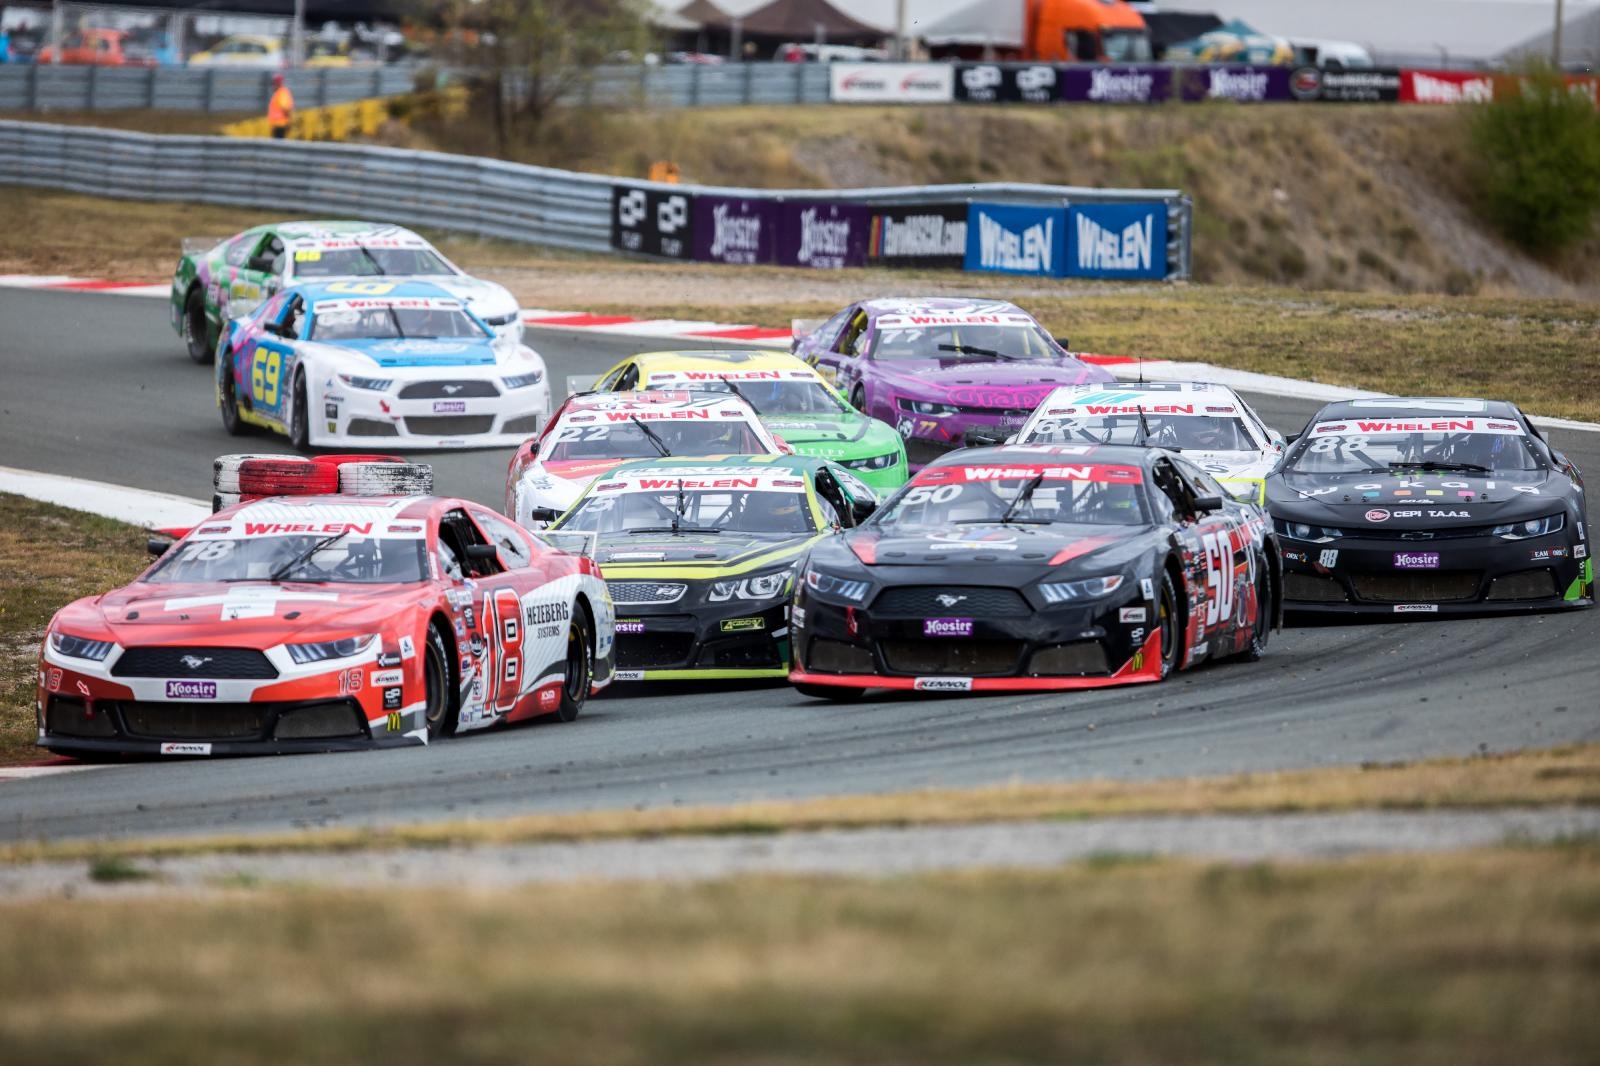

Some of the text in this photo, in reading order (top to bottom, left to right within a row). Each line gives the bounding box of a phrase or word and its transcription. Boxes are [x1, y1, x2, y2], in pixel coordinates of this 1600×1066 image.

[978, 211, 1053, 272] WHELEN
[1076, 211, 1153, 270] WHELEN
[252, 347, 281, 407] 69
[683, 370, 781, 380] WHELEN
[605, 408, 709, 421] WHELEN
[1086, 404, 1194, 415] WHELEN
[1357, 420, 1475, 432] WHELEN
[559, 425, 611, 443] 22
[1309, 435, 1371, 452] 88
[964, 466, 1094, 480] WHELEN
[638, 477, 759, 490] WHELEN
[900, 483, 964, 506] 50
[1393, 510, 1422, 518] CEPI
[244, 522, 374, 535] WHELEN
[1318, 549, 1339, 568] 88
[1394, 553, 1439, 566] Hoosier
[1203, 530, 1235, 626] 50
[526, 601, 569, 626] HEZEBERG
[615, 622, 645, 633] osier
[924, 618, 973, 633] Hoosier
[481, 588, 525, 718] 18
[167, 681, 216, 696] Hoosier
[338, 668, 364, 695] 18
